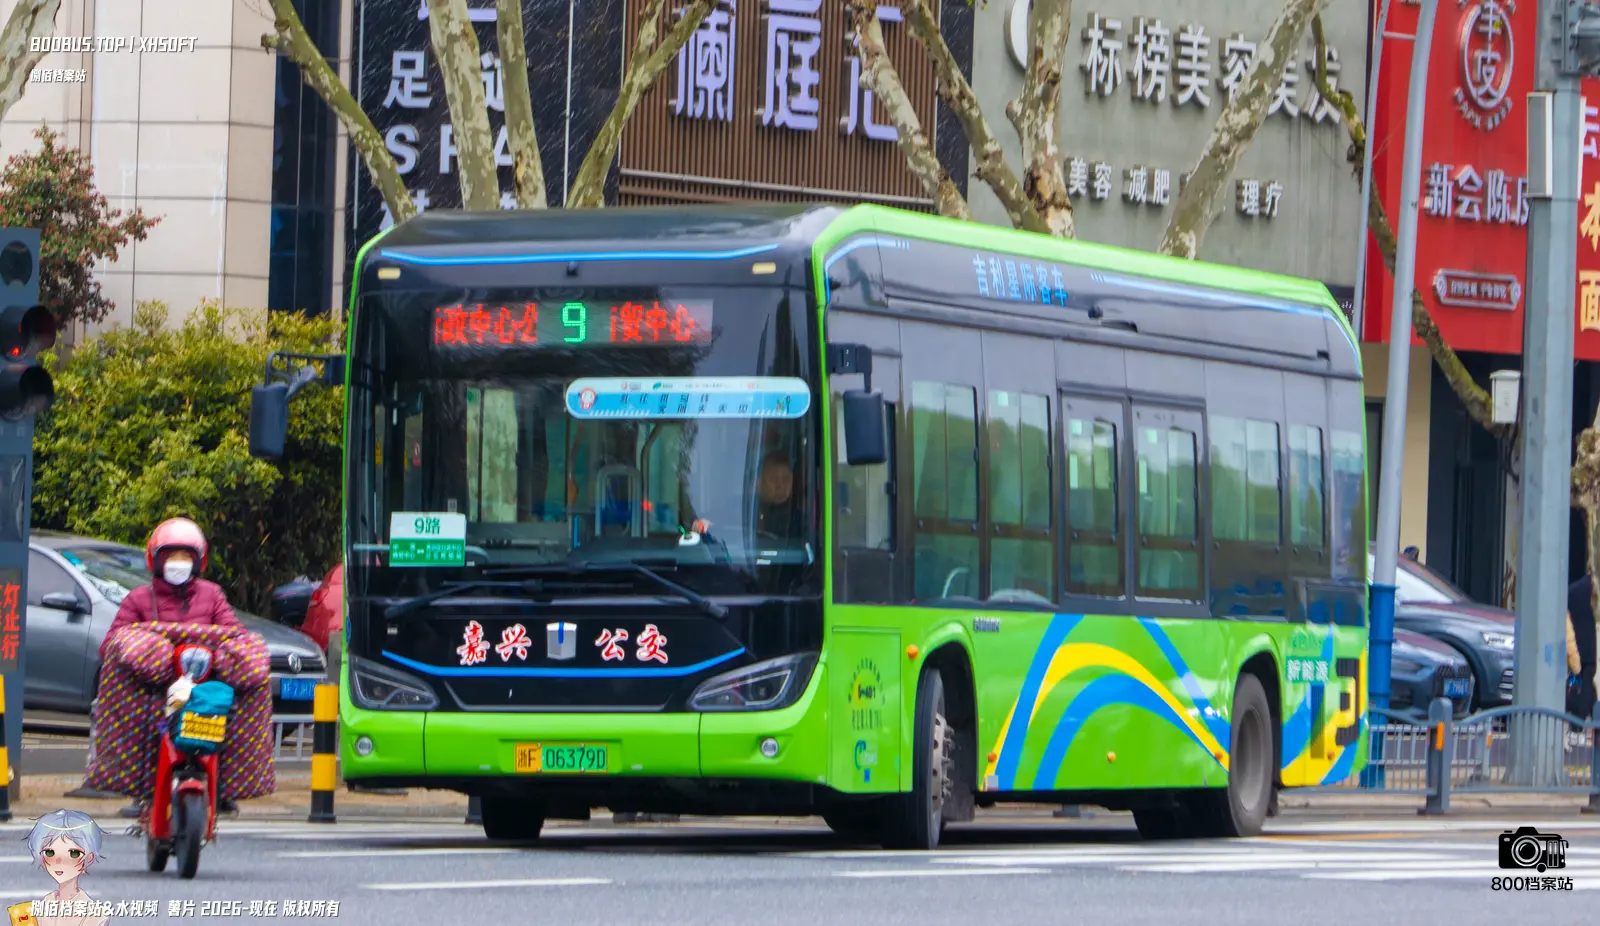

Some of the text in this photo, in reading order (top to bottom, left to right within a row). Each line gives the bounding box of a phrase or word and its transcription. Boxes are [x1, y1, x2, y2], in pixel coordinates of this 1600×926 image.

[1066, 156, 1284, 218] 美容 减肥 理疗
[972, 253, 1068, 308] 吉利星际客车
[562, 302, 587, 343] 9
[414, 516, 441, 535] 9路
[457, 620, 668, 666] 嘉兴 公交
[1287, 659, 1329, 682] 新能源
